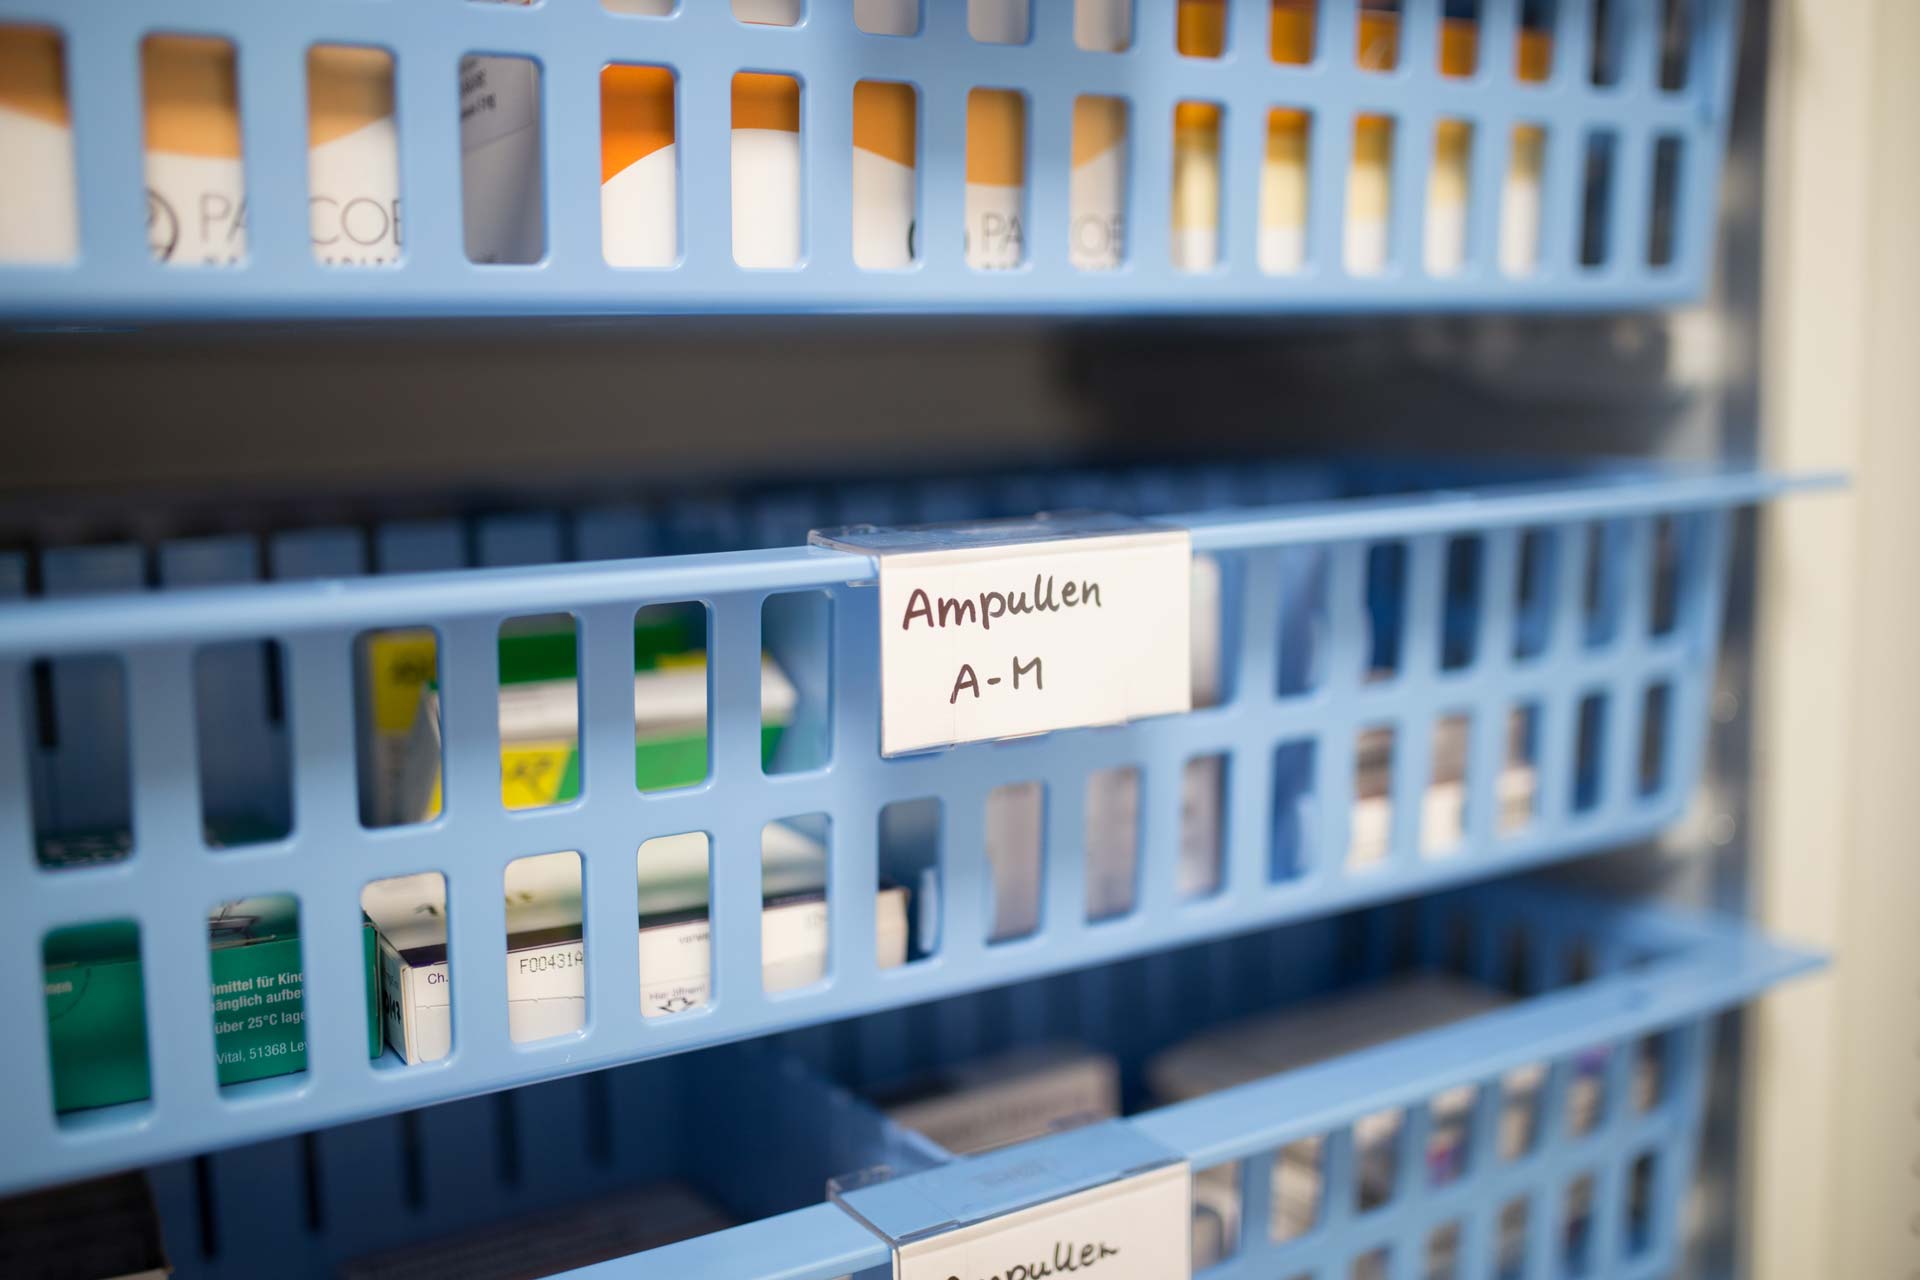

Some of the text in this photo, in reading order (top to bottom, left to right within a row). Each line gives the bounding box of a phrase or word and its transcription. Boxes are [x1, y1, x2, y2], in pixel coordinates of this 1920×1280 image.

[902, 573, 1102, 630] Ampullen
[949, 655, 1043, 705] A-M
[520, 951, 583, 975] F00431A
[256, 975, 275, 989] für
[427, 973, 449, 984] Ch.
[215, 1021, 244, 1034] über
[248, 1013, 278, 1029] 25°C
[249, 1042, 287, 1060] 51368
